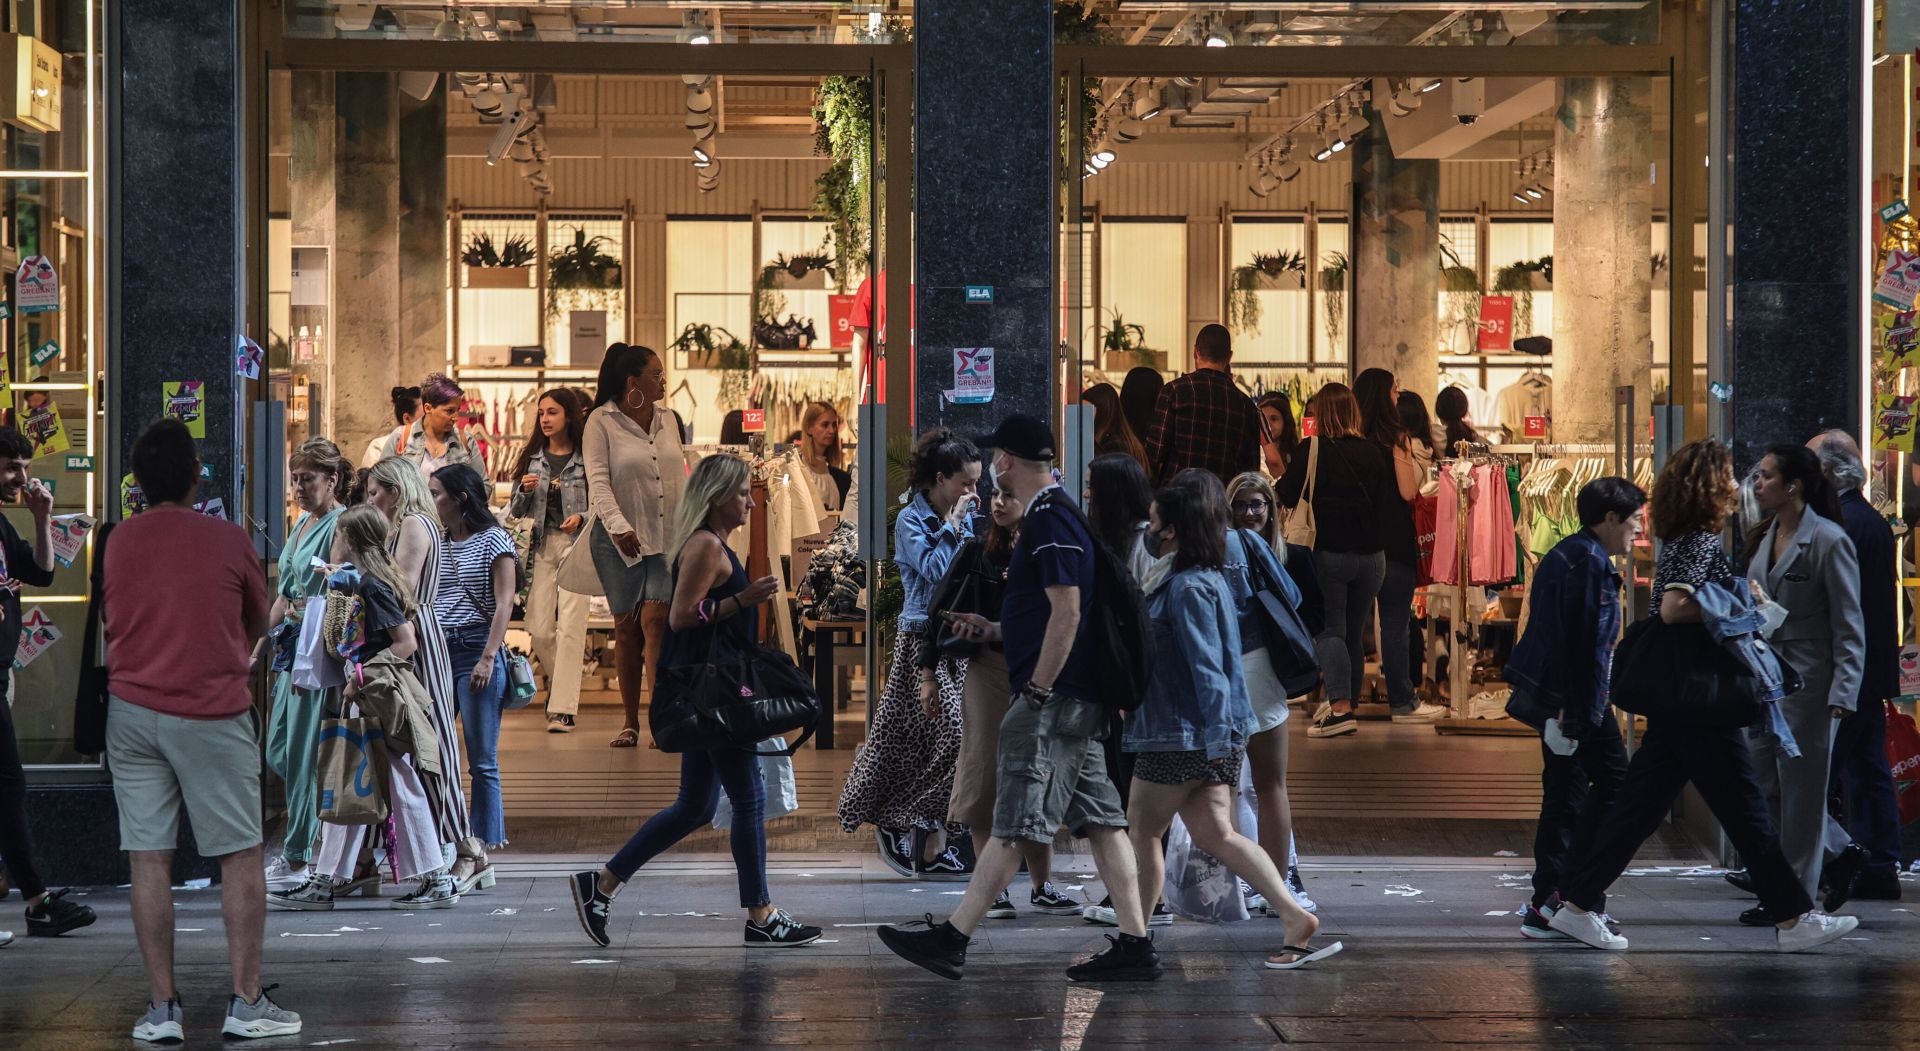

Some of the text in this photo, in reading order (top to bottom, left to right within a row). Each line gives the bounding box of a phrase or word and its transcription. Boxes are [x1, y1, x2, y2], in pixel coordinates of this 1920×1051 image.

[1882, 203, 1906, 219] ELA
[969, 289, 990, 298] ELA
[34, 344, 57, 362] ELA
[68, 458, 91, 467] ELA
